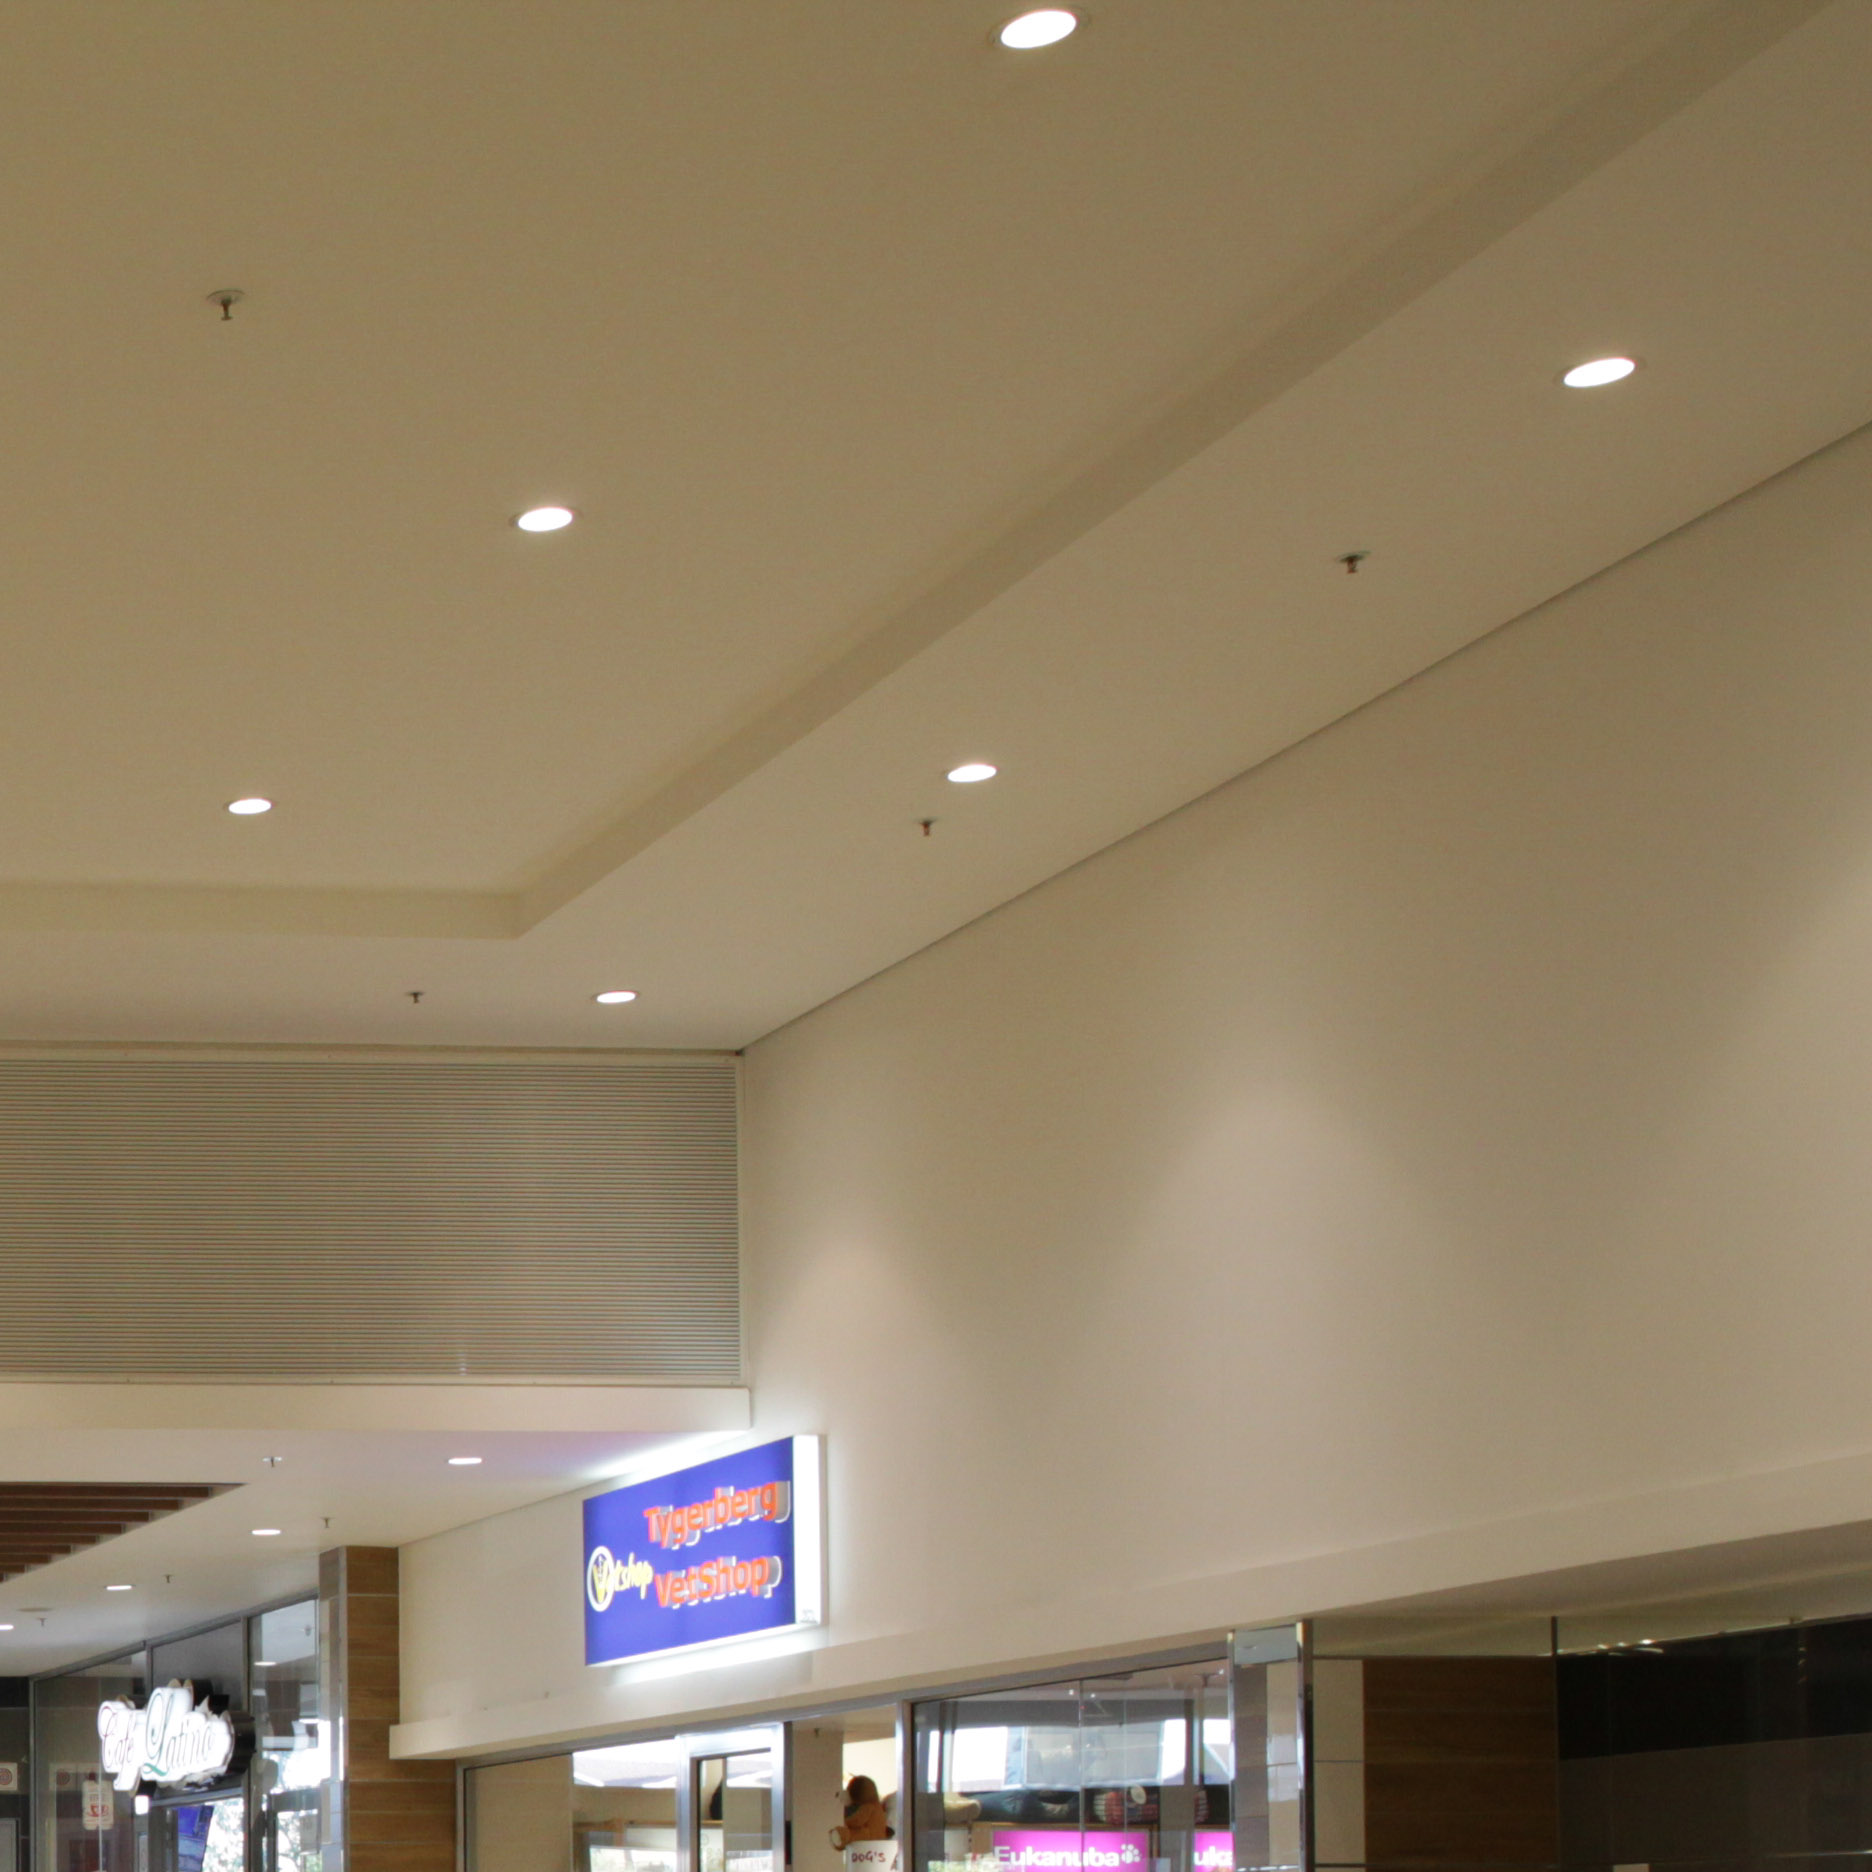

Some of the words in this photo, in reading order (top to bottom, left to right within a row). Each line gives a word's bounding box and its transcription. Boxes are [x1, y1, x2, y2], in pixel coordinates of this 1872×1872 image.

[643, 1481, 781, 1548] Tygerberg
[655, 1556, 774, 1608] VetShop
[994, 1846, 1120, 1867] Eukanuba
